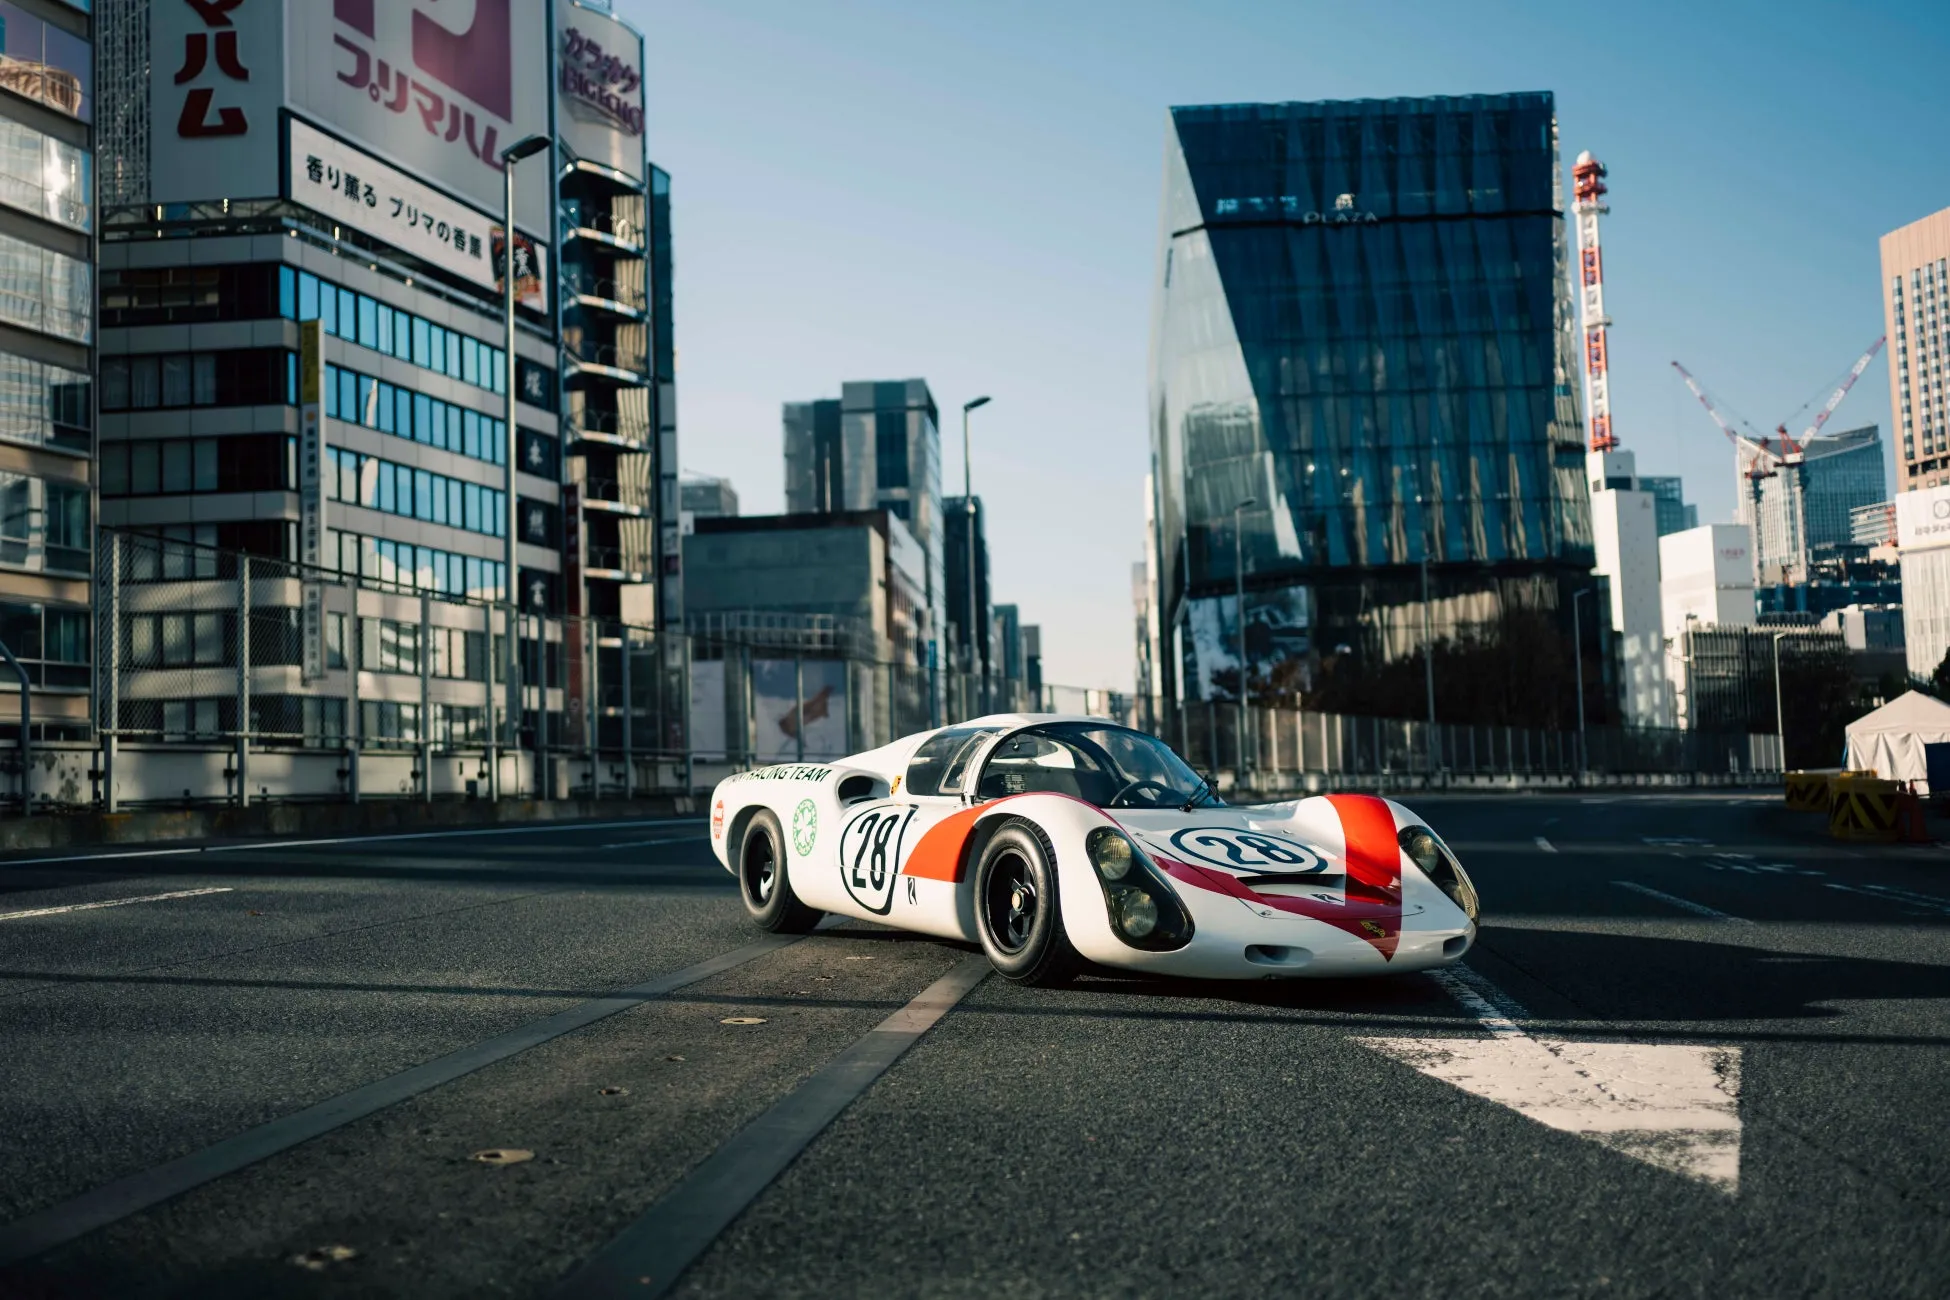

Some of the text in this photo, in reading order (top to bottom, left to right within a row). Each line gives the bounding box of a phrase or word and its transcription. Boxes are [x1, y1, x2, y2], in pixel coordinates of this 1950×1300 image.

[565, 27, 640, 93] カラオケ
[307, 154, 377, 208] 香り薫る
[790, 766, 832, 783] TEAM
[852, 812, 900, 891] 28
[1196, 835, 1305, 865] 28
